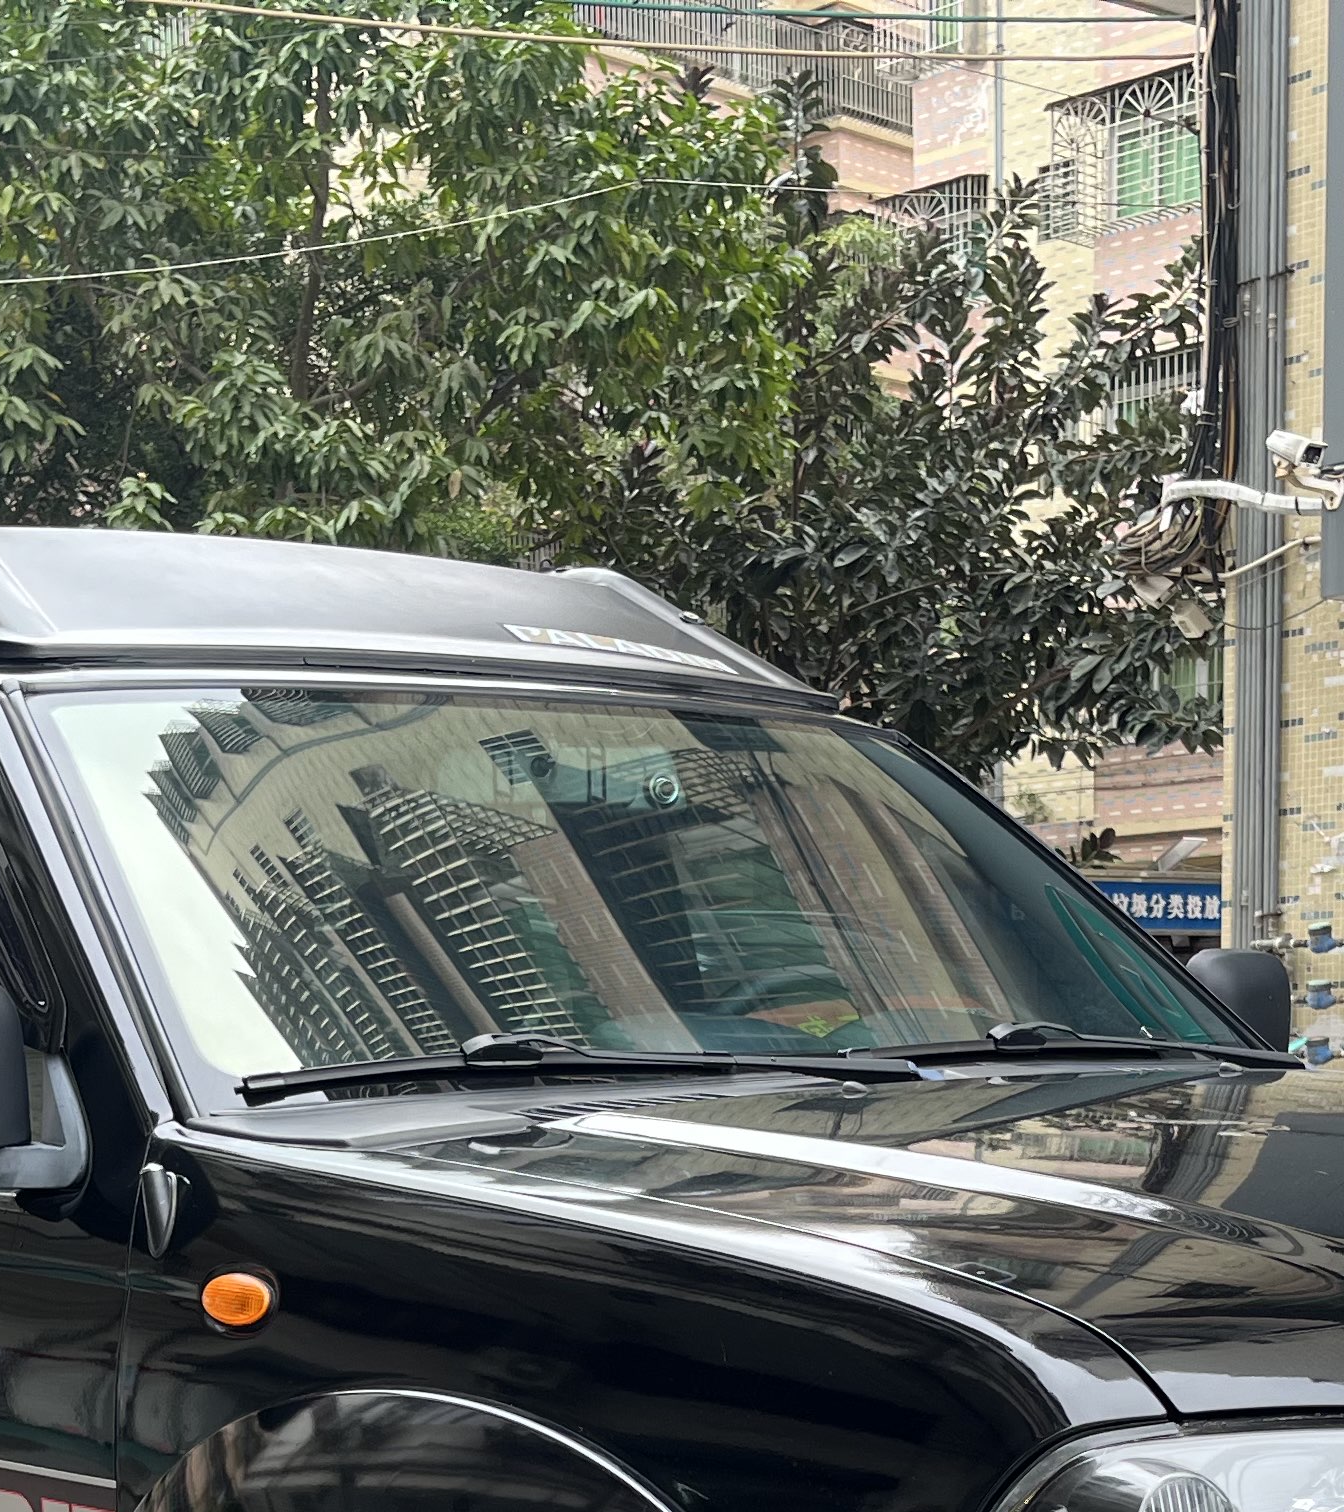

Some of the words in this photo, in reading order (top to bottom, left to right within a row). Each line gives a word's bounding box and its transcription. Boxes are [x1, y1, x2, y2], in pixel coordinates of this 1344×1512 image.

[1104, 892, 1221, 920] 垃圾分类投放
